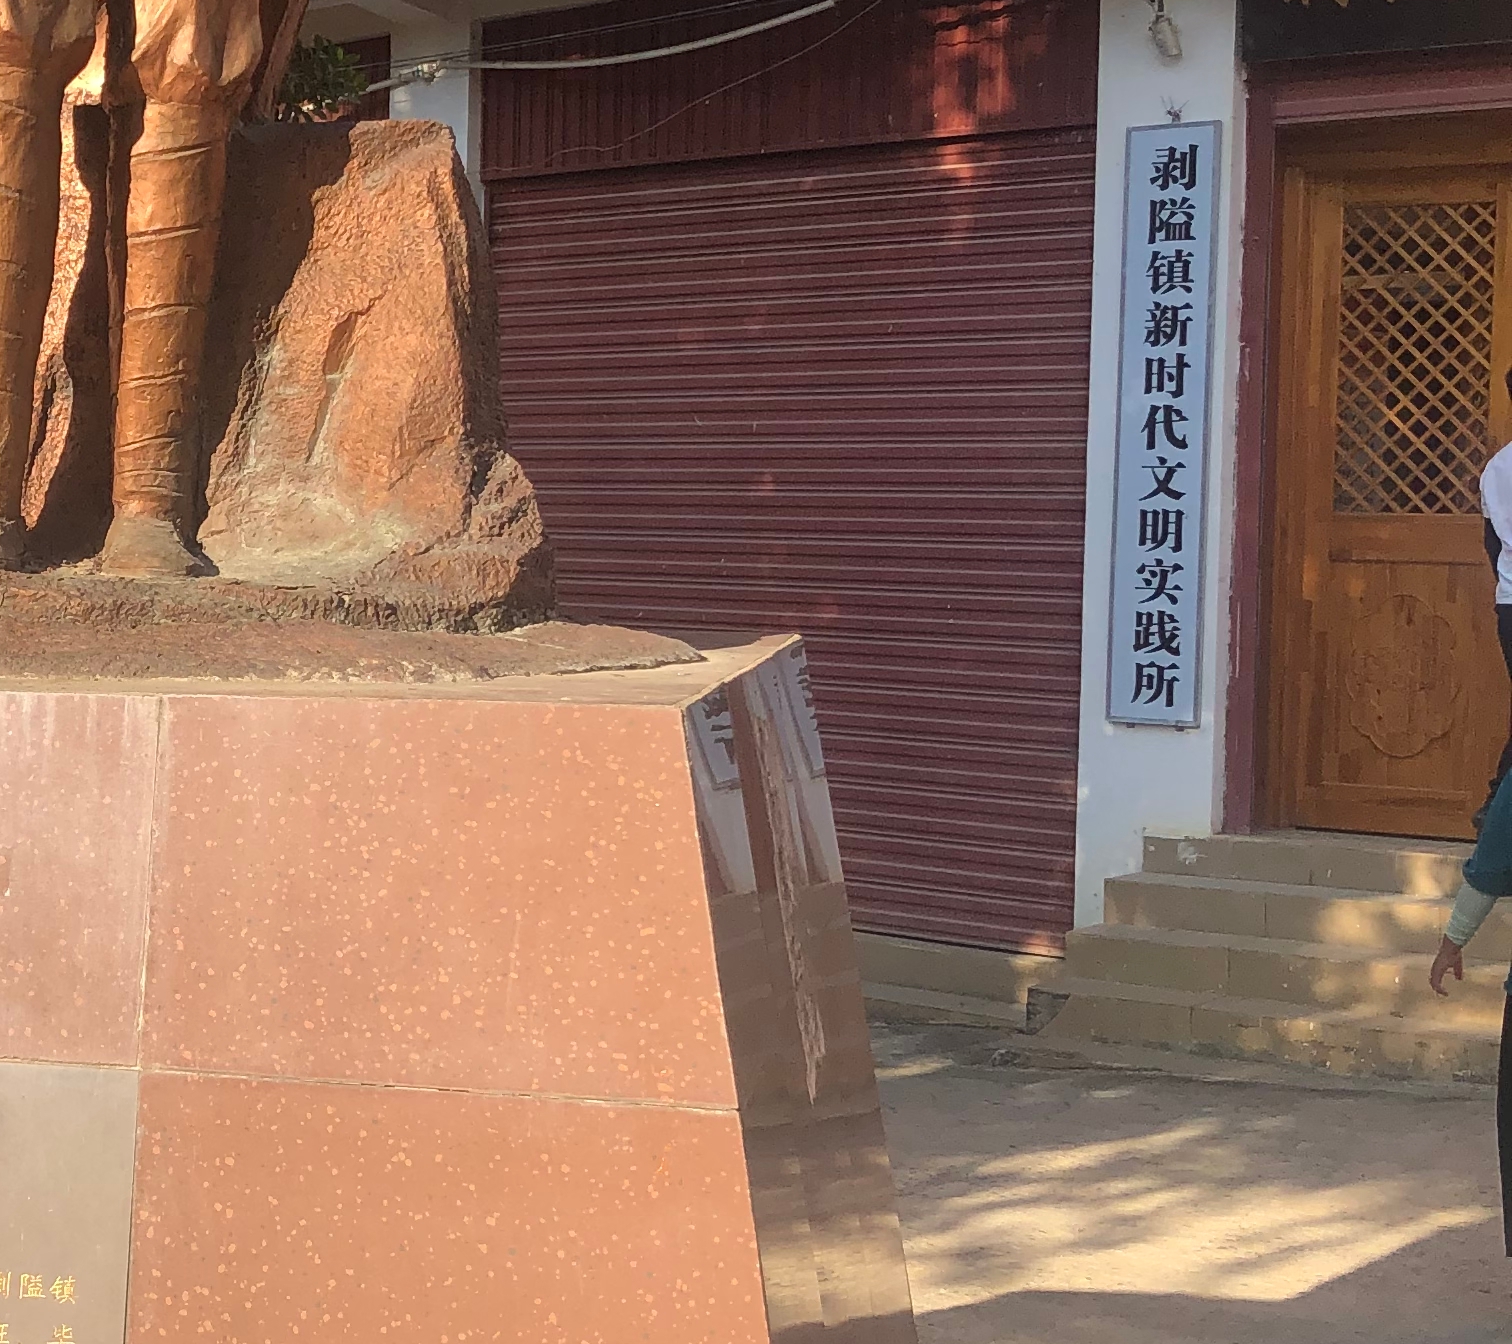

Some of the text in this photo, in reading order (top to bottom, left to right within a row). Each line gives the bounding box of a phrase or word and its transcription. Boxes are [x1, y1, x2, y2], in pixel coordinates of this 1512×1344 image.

[1130, 143, 1199, 709] 剥隘镇新时代文明实践所
